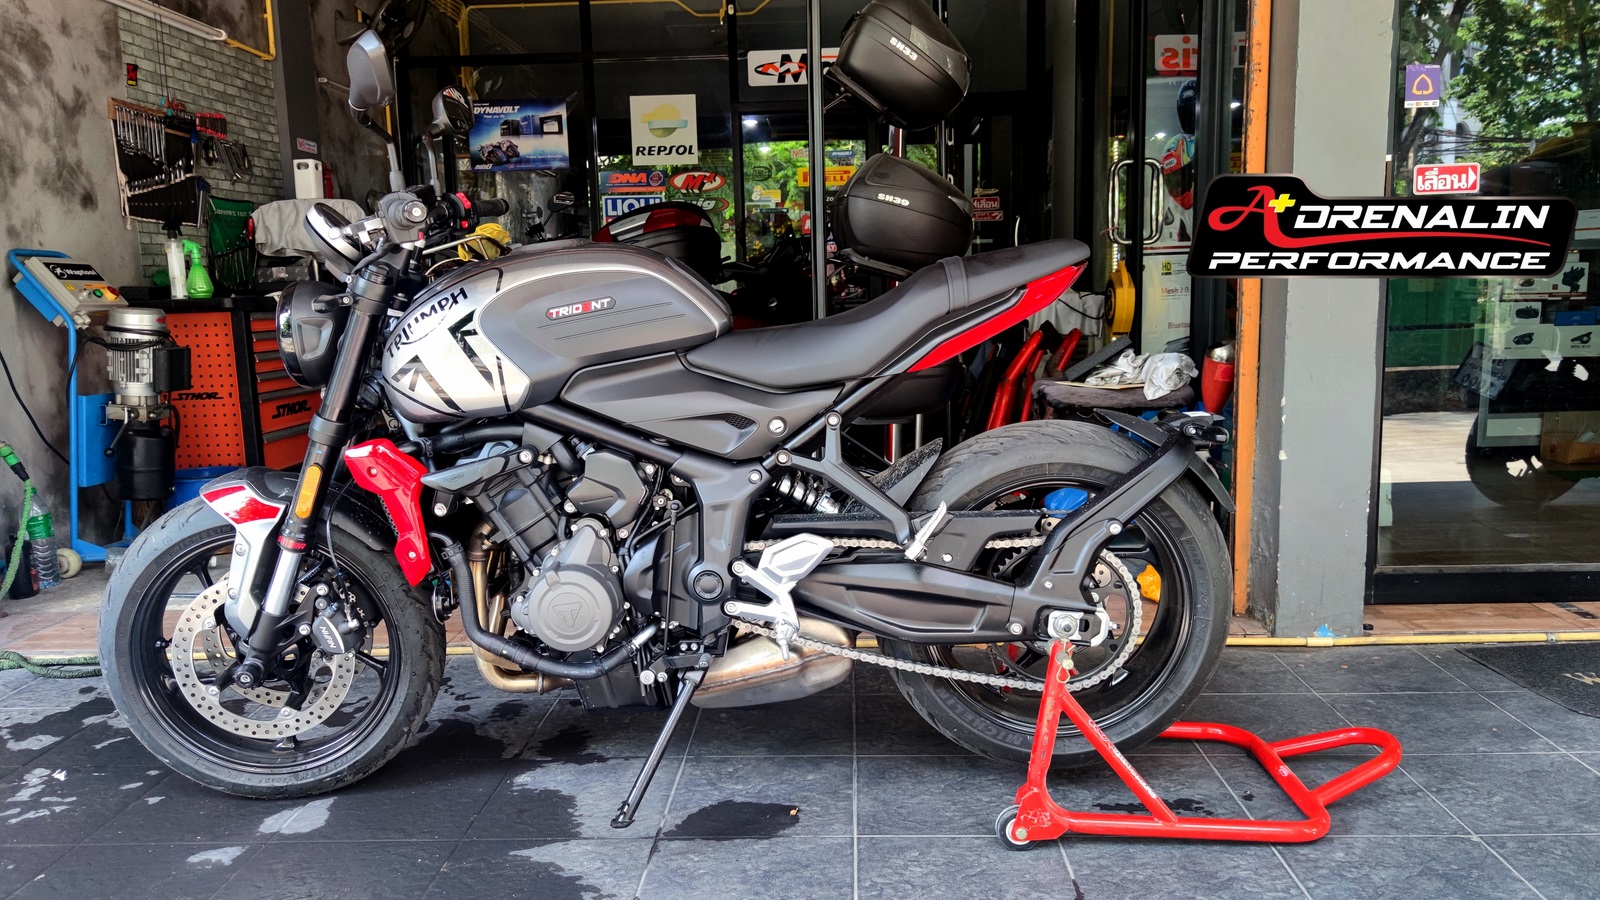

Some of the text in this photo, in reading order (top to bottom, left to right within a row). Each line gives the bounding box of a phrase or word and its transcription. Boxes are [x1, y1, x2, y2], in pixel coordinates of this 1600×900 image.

[890, 36, 918, 61] SH33
[473, 105, 520, 114] DYNAVOLT
[635, 144, 695, 157] REPSOL
[608, 172, 647, 183] DNA
[1416, 167, 1468, 191] เลื่อน
[878, 193, 910, 206] SH39
[1162, 262, 1172, 271] HD
[1161, 286, 1179, 294] Mesh
[548, 298, 611, 319] TRIDENT
[272, 399, 312, 419] STHOR
